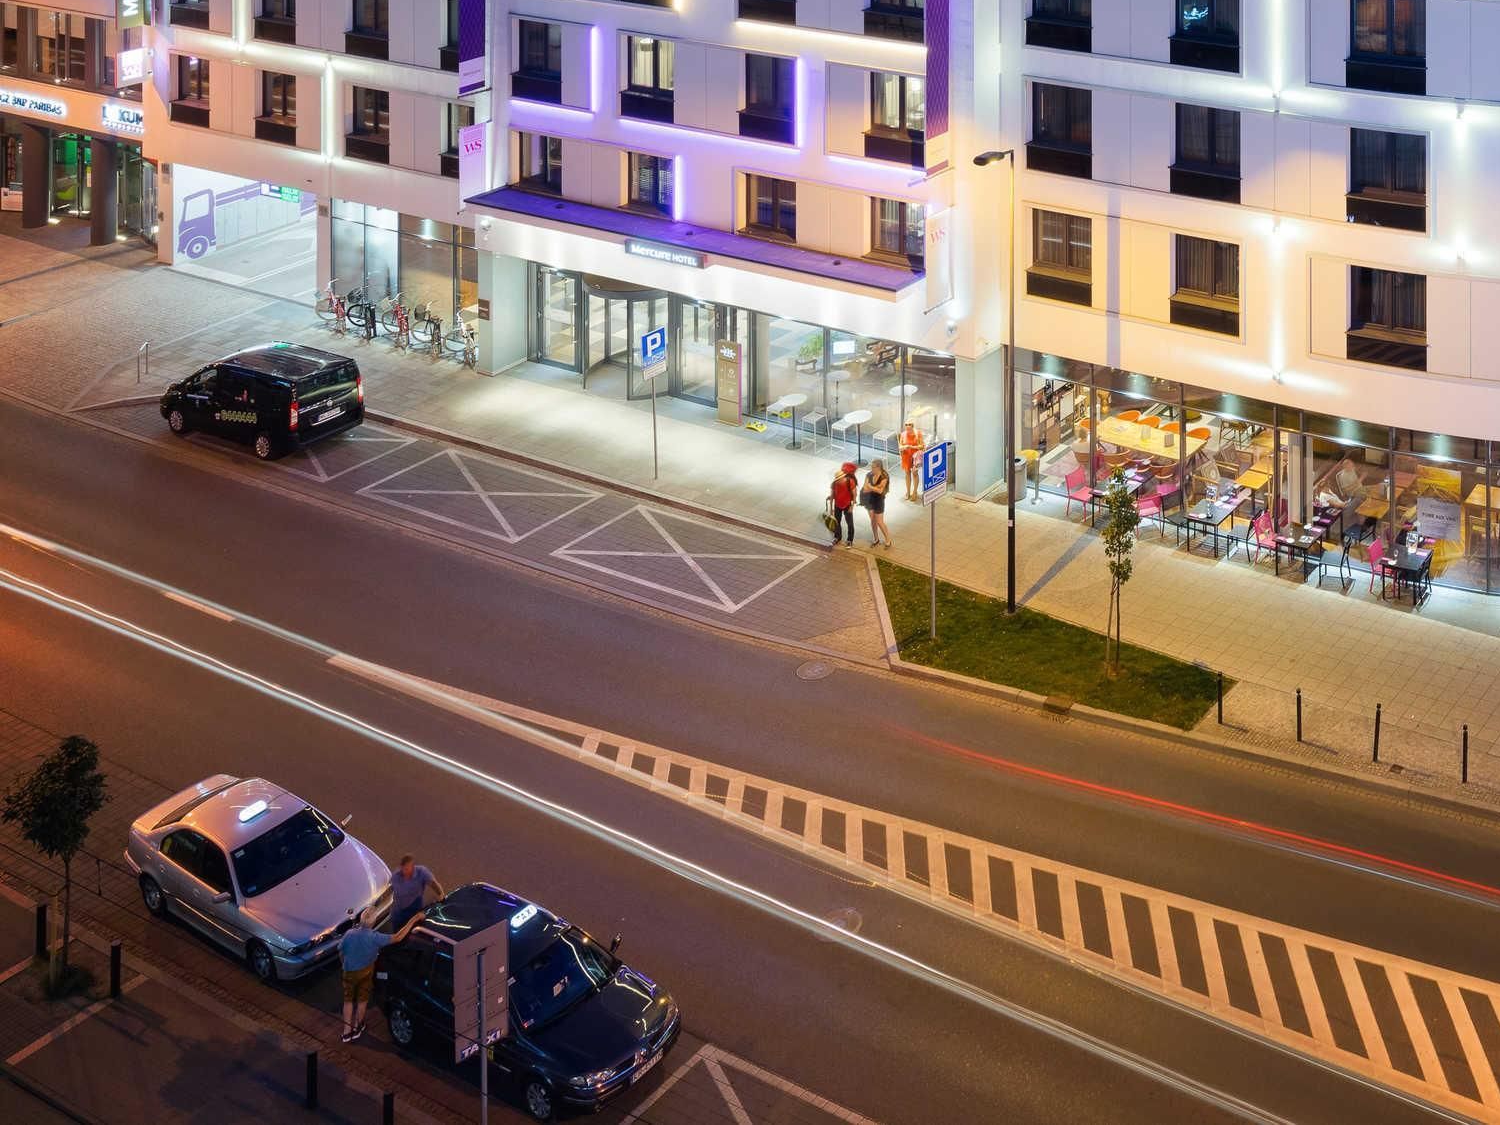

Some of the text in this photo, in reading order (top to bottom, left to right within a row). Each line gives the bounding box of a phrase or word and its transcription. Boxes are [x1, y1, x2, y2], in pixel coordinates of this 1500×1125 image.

[102, 104, 143, 125] LKUM
[630, 243, 698, 267] Mercure HOTEL
[646, 332, 662, 357] P
[928, 448, 943, 479] P
